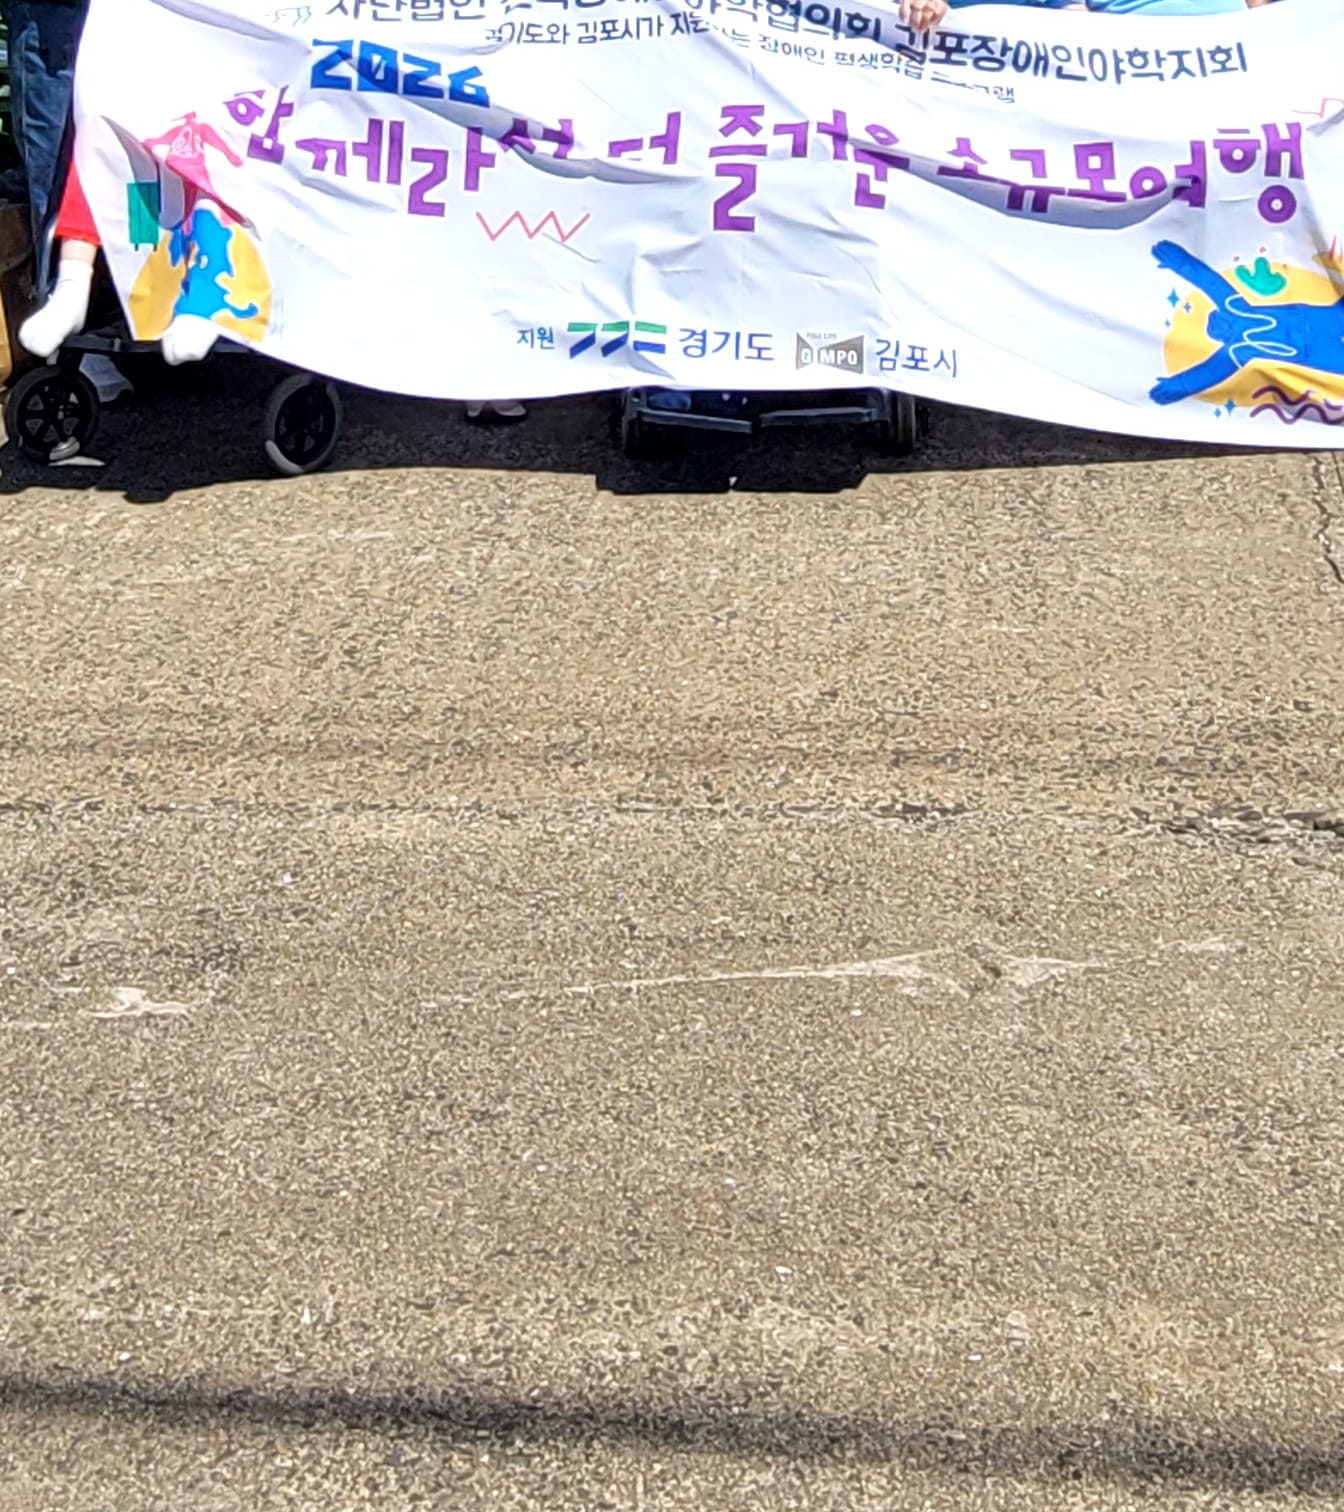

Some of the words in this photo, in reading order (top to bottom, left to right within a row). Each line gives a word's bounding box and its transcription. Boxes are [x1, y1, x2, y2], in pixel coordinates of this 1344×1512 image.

[576, 15, 664, 45] 김포시가
[894, 23, 1249, 85] 김포장애인야학지회
[708, 103, 910, 232] 즐거운
[935, 121, 1305, 225] 소규모여행
[515, 326, 555, 350] 지원
[678, 326, 776, 363] 경기도
[875, 338, 957, 379] 김포시
